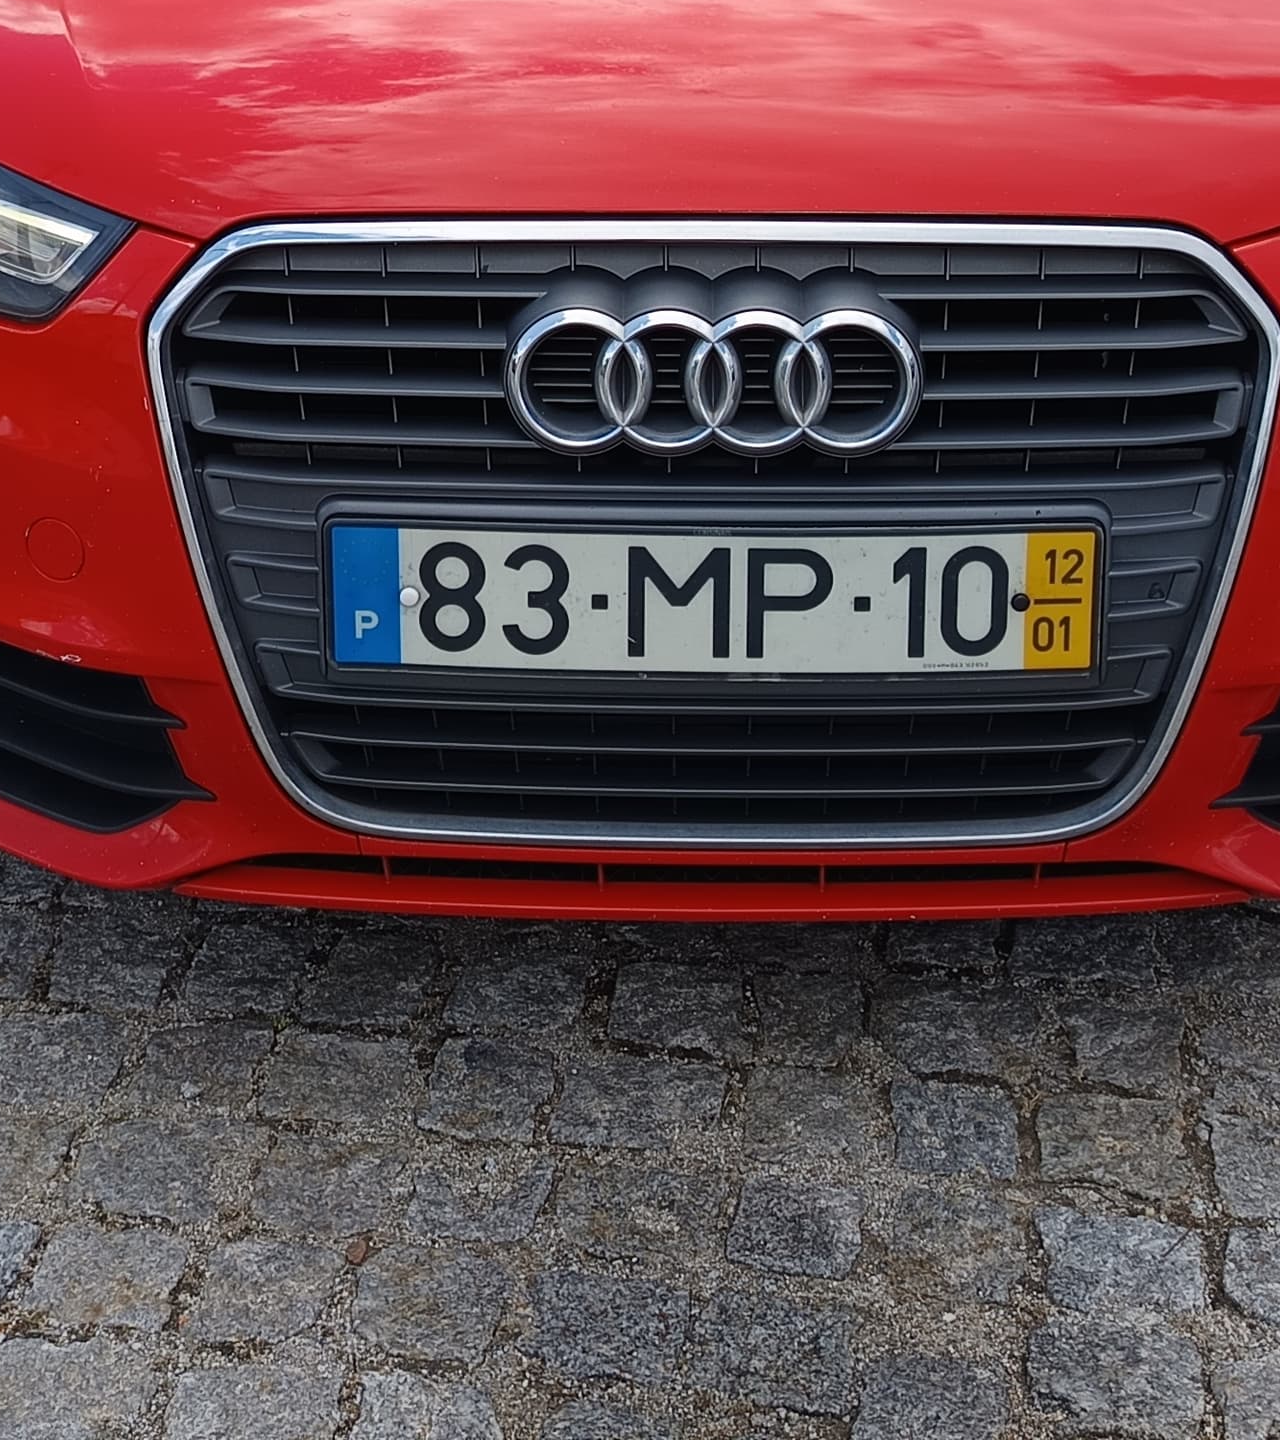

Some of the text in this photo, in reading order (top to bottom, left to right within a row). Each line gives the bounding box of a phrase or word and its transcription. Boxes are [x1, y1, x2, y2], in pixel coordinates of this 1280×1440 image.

[1044, 548, 1086, 585] 12
[354, 609, 380, 640] P
[1032, 615, 1071, 652] 01
